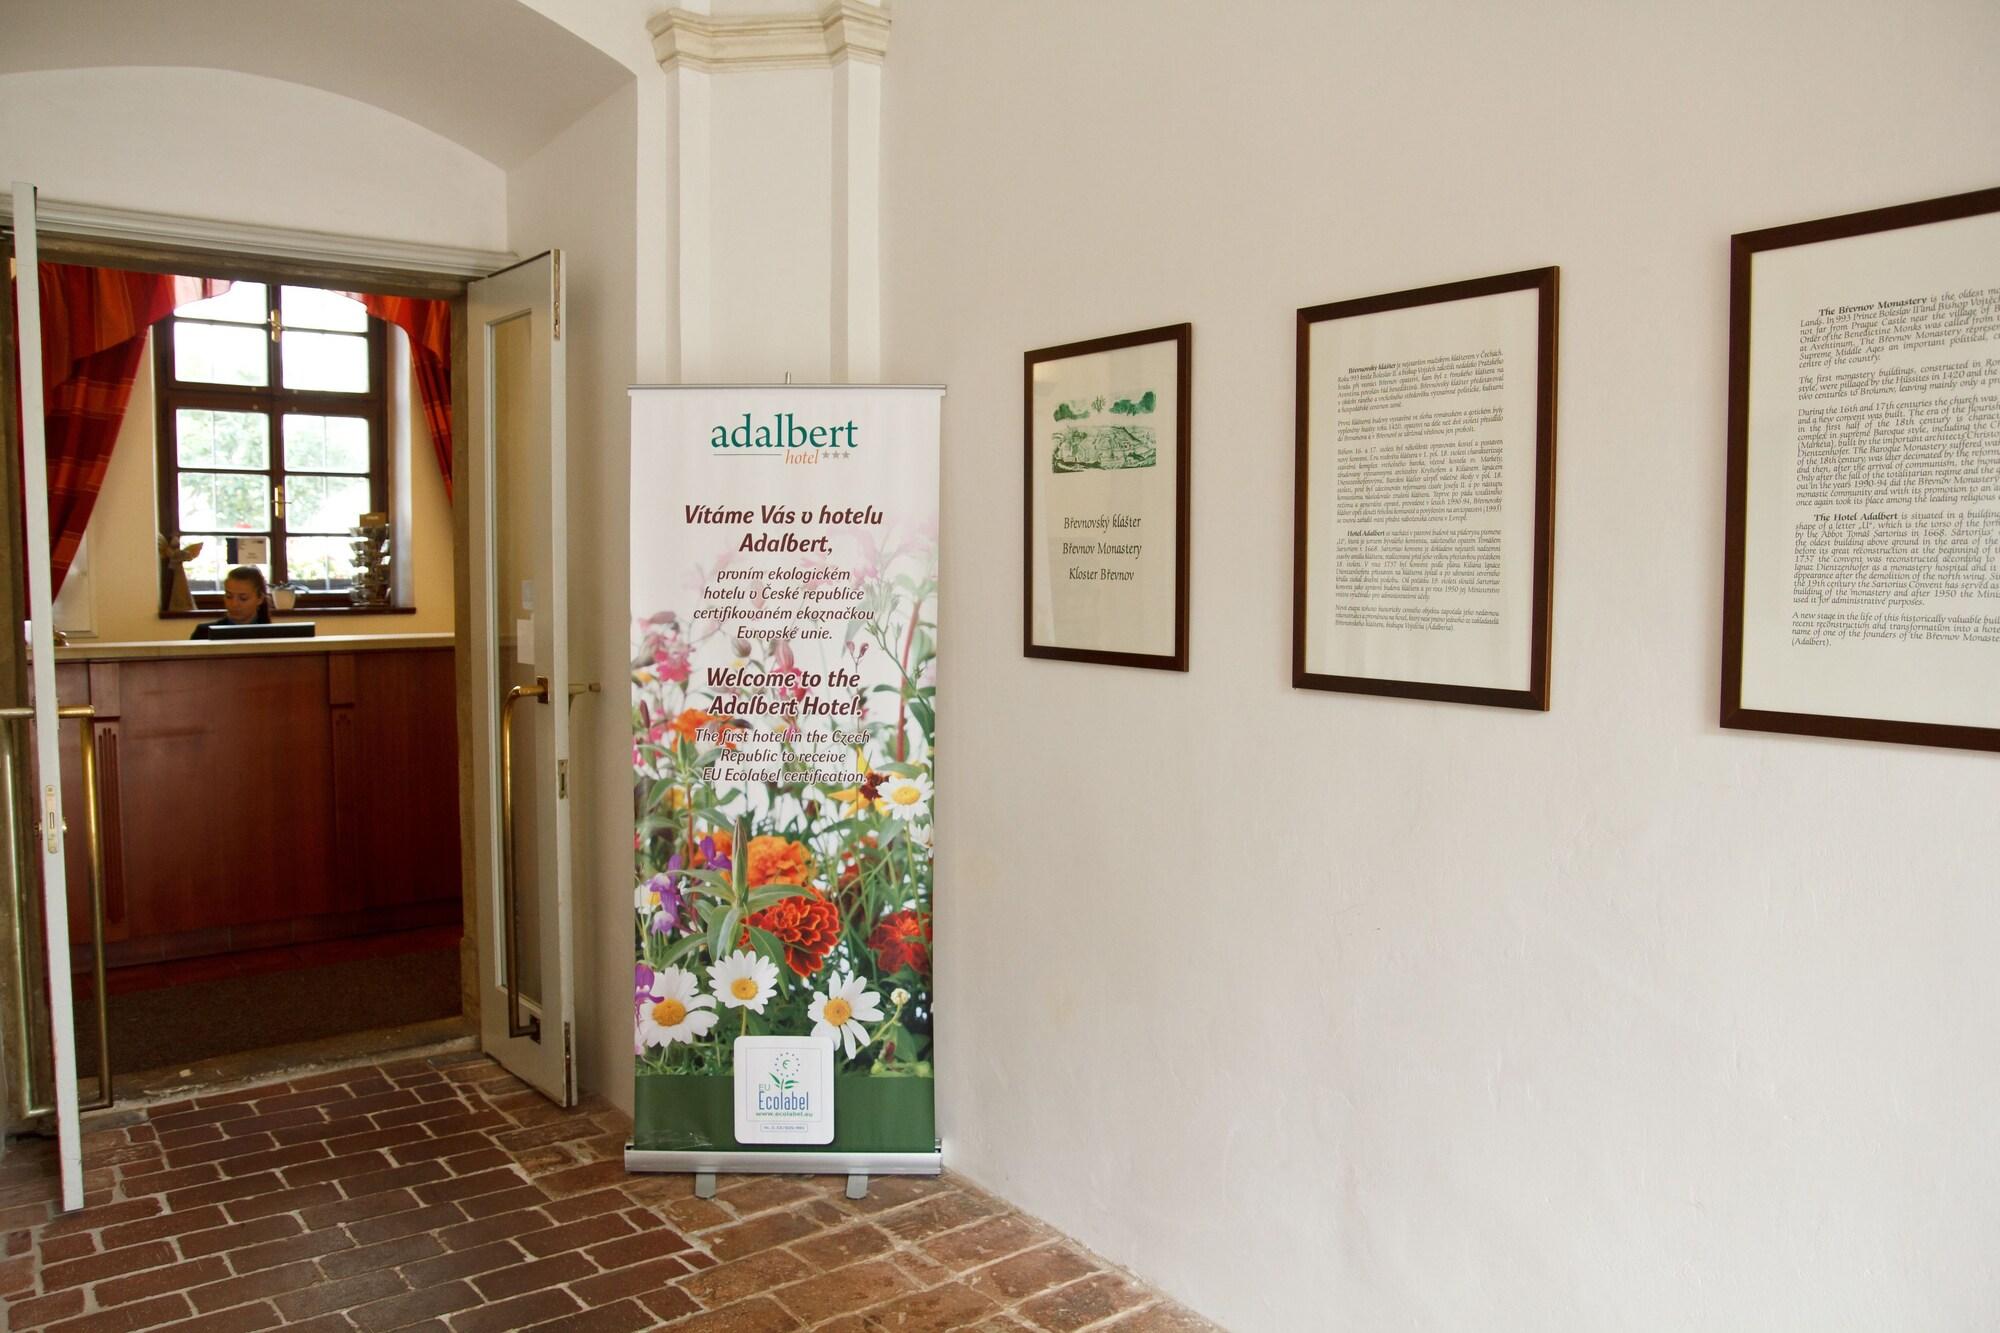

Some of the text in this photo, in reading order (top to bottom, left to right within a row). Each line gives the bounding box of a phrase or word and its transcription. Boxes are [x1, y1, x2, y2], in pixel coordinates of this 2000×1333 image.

[1819, 307, 1835, 316] The
[1877, 297, 1927, 310] Monastery
[1941, 291, 1955, 301] the
[1958, 289, 1983, 299] oldest
[1836, 314, 1851, 323] 993
[1853, 311, 1877, 321] Prince
[1879, 307, 1911, 319] Boleslav
[1921, 303, 1936, 313] and
[1938, 299, 1968, 311] Bishop
[1800, 335, 1821, 344] Order
[1831, 332, 1842, 341] the
[1844, 327, 1890, 339] Benedictine
[1893, 323, 1921, 333] Monks
[1925, 322, 1941, 330] was
[1944, 317, 1969, 327] called
[1971, 315, 1993, 326] from
[1830, 324, 1848, 336] from
[1852, 321, 1878, 331] Prague
[1881, 316, 1906, 326] Castle
[1910, 315, 1928, 323] near
[1932, 312, 1945, 321] the
[1949, 308, 1977, 319] village
[1861, 337, 1874, 346] The
[1915, 328, 1962, 340] Monastery
[1800, 351, 1831, 361] Supreme
[1836, 345, 1862, 357] Middle
[1865, 345, 1885, 354] Ages
[1888, 343, 1899, 351] an
[1903, 338, 1945, 352] important
[1799, 361, 1822, 369] centre
[1834, 356, 1846, 365] the
[1820, 383, 1838, 391] were
[1840, 378, 1869, 392] pillaged
[1881, 376, 1894, 385] the
[1896, 374, 1930, 384] Hussites
[1943, 370, 1965, 380] 1420
[1966, 368, 1982, 378] and
[1984, 367, 1998, 376] the
[1798, 394, 1998, 417] During the 16th and 17th centuries the church was
[711, 413, 858, 465] adalbert hotel
[684, 505, 883, 525] Vítáme Vás v hotelu
[1814, 513, 1830, 522] The
[1834, 512, 1858, 521] Hotel
[1860, 511, 1898, 521] Adalbert
[1911, 511, 1943, 520] situated
[1807, 530, 1818, 538] the
[1821, 529, 1843, 538] Abbot
[1874, 529, 1908, 538] Sartorius
[738, 533, 833, 556] Adalbert,
[1097, 541, 1142, 560] Monastery
[717, 566, 850, 584] prvním ekologickém
[1069, 566, 1099, 580] Kloster
[703, 583, 865, 603] hotelu v České republice
[1445, 585, 1459, 593] 1950
[693, 606, 875, 623] certifikovaném ekoznačkou
[1817, 612, 1836, 622] stage
[1846, 611, 1859, 621] the
[1860, 611, 1873, 622] life
[1884, 613, 1900, 622] this
[1900, 613, 1947, 624] historically
[1948, 614, 1982, 624] valuable
[736, 625, 833, 643] Evropské unie.
[1791, 637, 1832, 647] (Adalbert).
[1823, 629, 1837, 637] one
[1848, 629, 1861, 638] the
[1862, 629, 1897, 640] founders
[1910, 630, 1923, 640] the
[706, 667, 861, 688] Welcome to the
[708, 695, 862, 717] Adalbert Hotel.
[694, 728, 871, 747] The first hotel in the Czech
[720, 749, 847, 766] Republic to receive
[702, 767, 868, 786] EU Ecolabel certification.
[758, 1091, 809, 1111] Ecolabel
